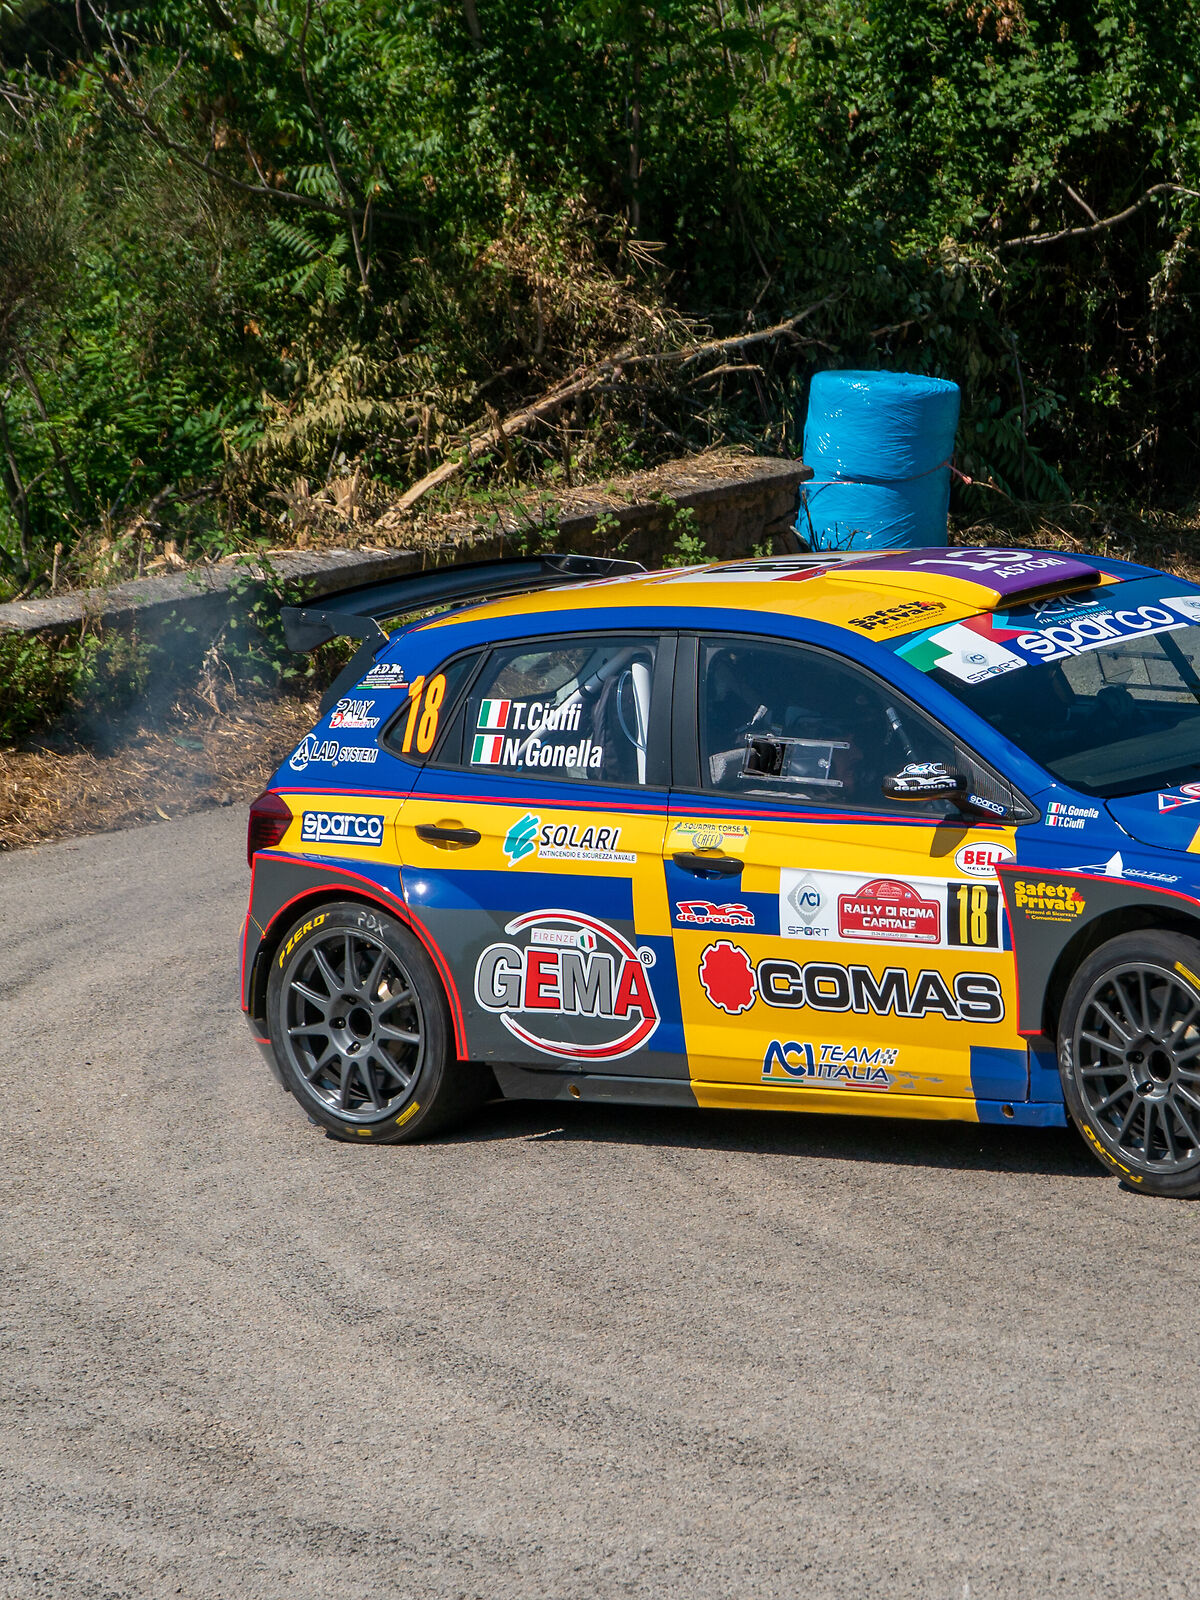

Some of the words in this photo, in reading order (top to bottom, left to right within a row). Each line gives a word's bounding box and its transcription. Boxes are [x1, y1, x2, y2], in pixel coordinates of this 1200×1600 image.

[909, 550, 1034, 571] 13
[993, 557, 1067, 579] ASTORI
[848, 601, 921, 626] Safety
[860, 602, 947, 630] Privacy
[1016, 606, 1175, 656] sparco
[967, 659, 1021, 682] SPORT
[337, 699, 375, 719] RALLY
[402, 673, 446, 753] 18
[513, 702, 582, 731] T.Ciuffi
[339, 747, 378, 763] SYSTEM
[502, 738, 603, 768] N.Gonella
[970, 795, 1004, 813] sparco
[1060, 802, 1099, 818] N.Gonella
[303, 813, 382, 842] sparco
[683, 823, 716, 831] SQUADRA
[1057, 815, 1085, 829] T.Ciuffi
[540, 825, 620, 850] SOLARI
[538, 850, 576, 858] ANTINCENDIO
[1014, 881, 1076, 899] Safety
[843, 904, 882, 915] RALLY
[885, 906, 897, 916] DI
[900, 907, 935, 918] ROMA
[1016, 895, 1086, 914] Privacy
[677, 914, 755, 925] d6group.it
[862, 917, 917, 929] CAPITALE
[956, 885, 988, 945] 18
[533, 932, 574, 943] FIRENZE
[787, 926, 829, 936] SPORT
[477, 947, 658, 1020] GEMA
[758, 961, 1003, 1021] COMAS
[762, 1040, 815, 1077] ACI
[820, 1045, 881, 1062] TEAM
[817, 1064, 889, 1082] ITALIA
